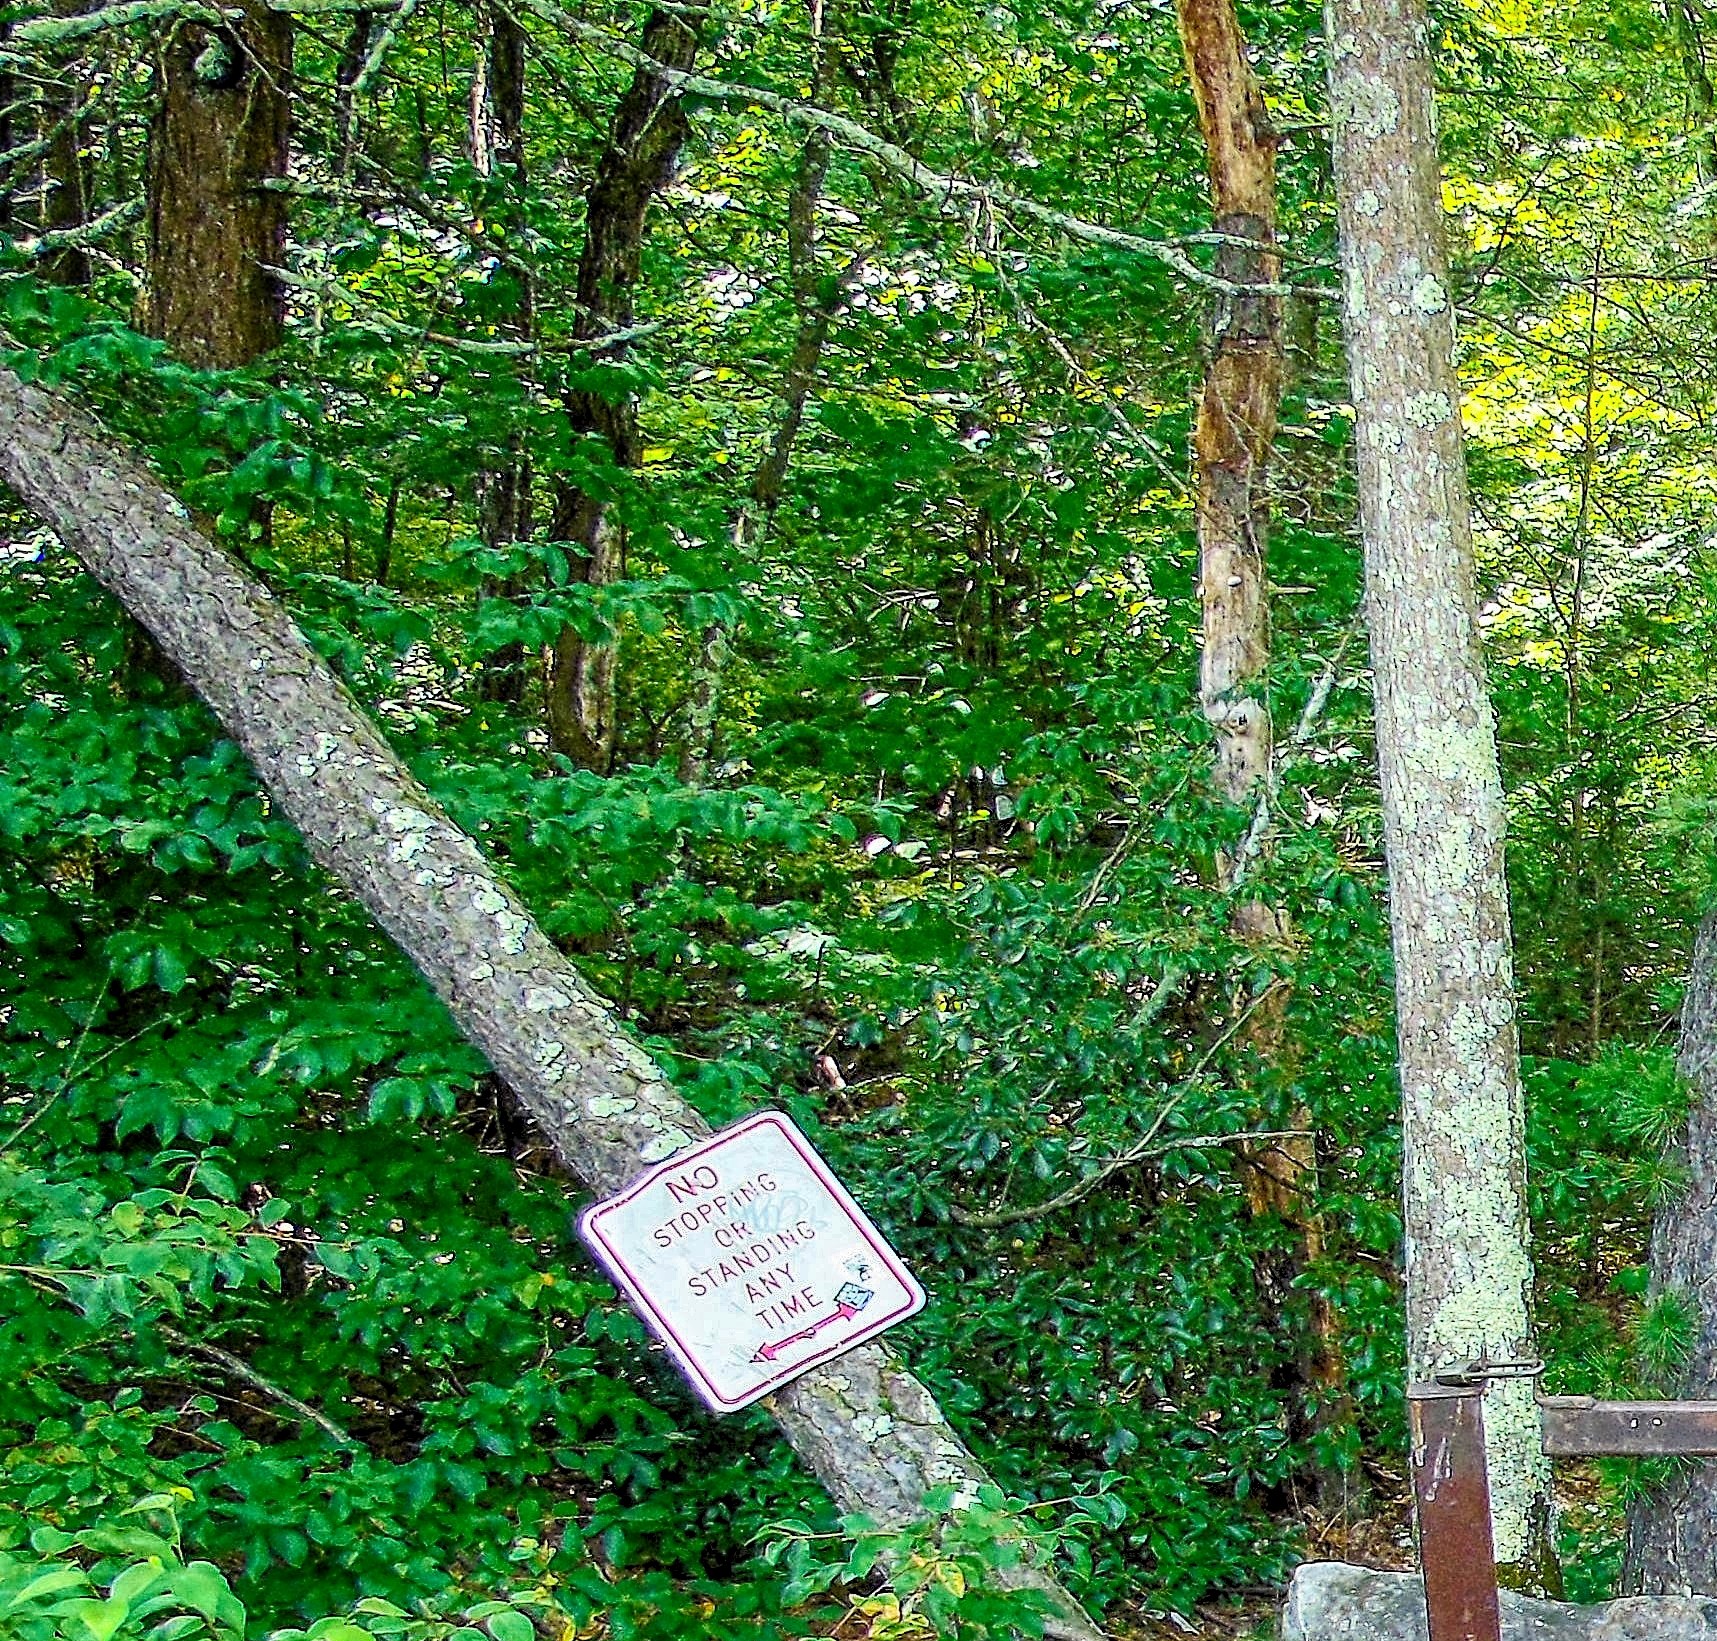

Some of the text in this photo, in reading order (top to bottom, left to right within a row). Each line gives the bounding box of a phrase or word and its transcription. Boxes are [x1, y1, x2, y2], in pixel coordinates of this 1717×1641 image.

[666, 1165, 721, 1203] NO
[653, 1173, 778, 1248] STOPPING
[714, 1220, 755, 1249] OR
[688, 1220, 817, 1297] STANDING
[744, 1263, 800, 1304] ANY
[756, 1285, 825, 1330] TIME
